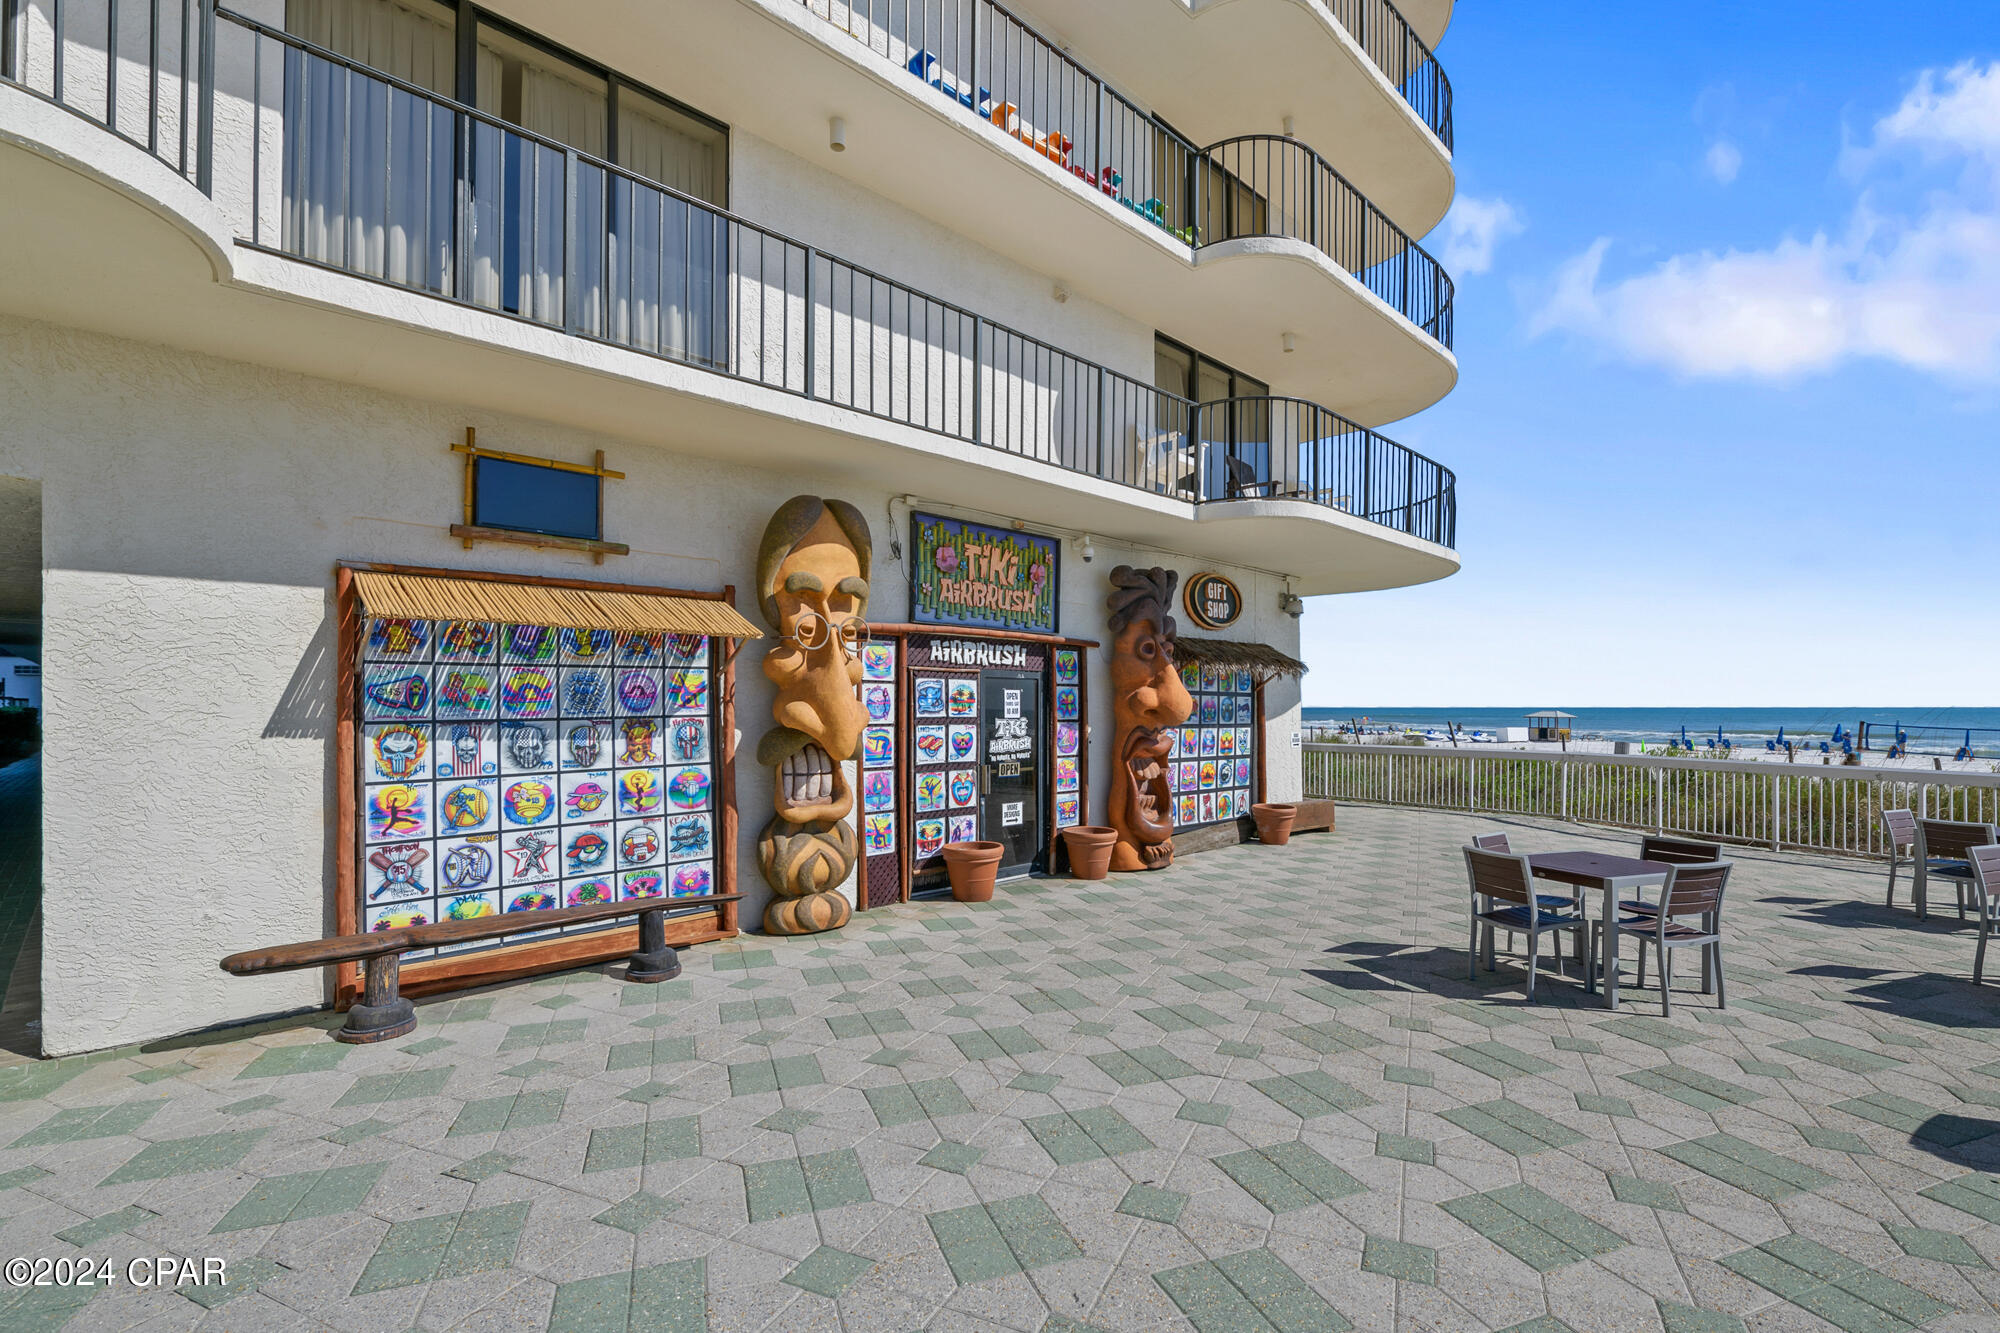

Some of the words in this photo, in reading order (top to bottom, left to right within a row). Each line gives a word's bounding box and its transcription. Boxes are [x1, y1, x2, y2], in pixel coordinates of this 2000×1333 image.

[1207, 582, 1228, 601] GIFT
[1207, 600, 1229, 619] SHOP
[1006, 692, 1019, 700] OPEN
[1000, 763, 1019, 776] OPEN
[668, 813, 707, 828] KEATON
